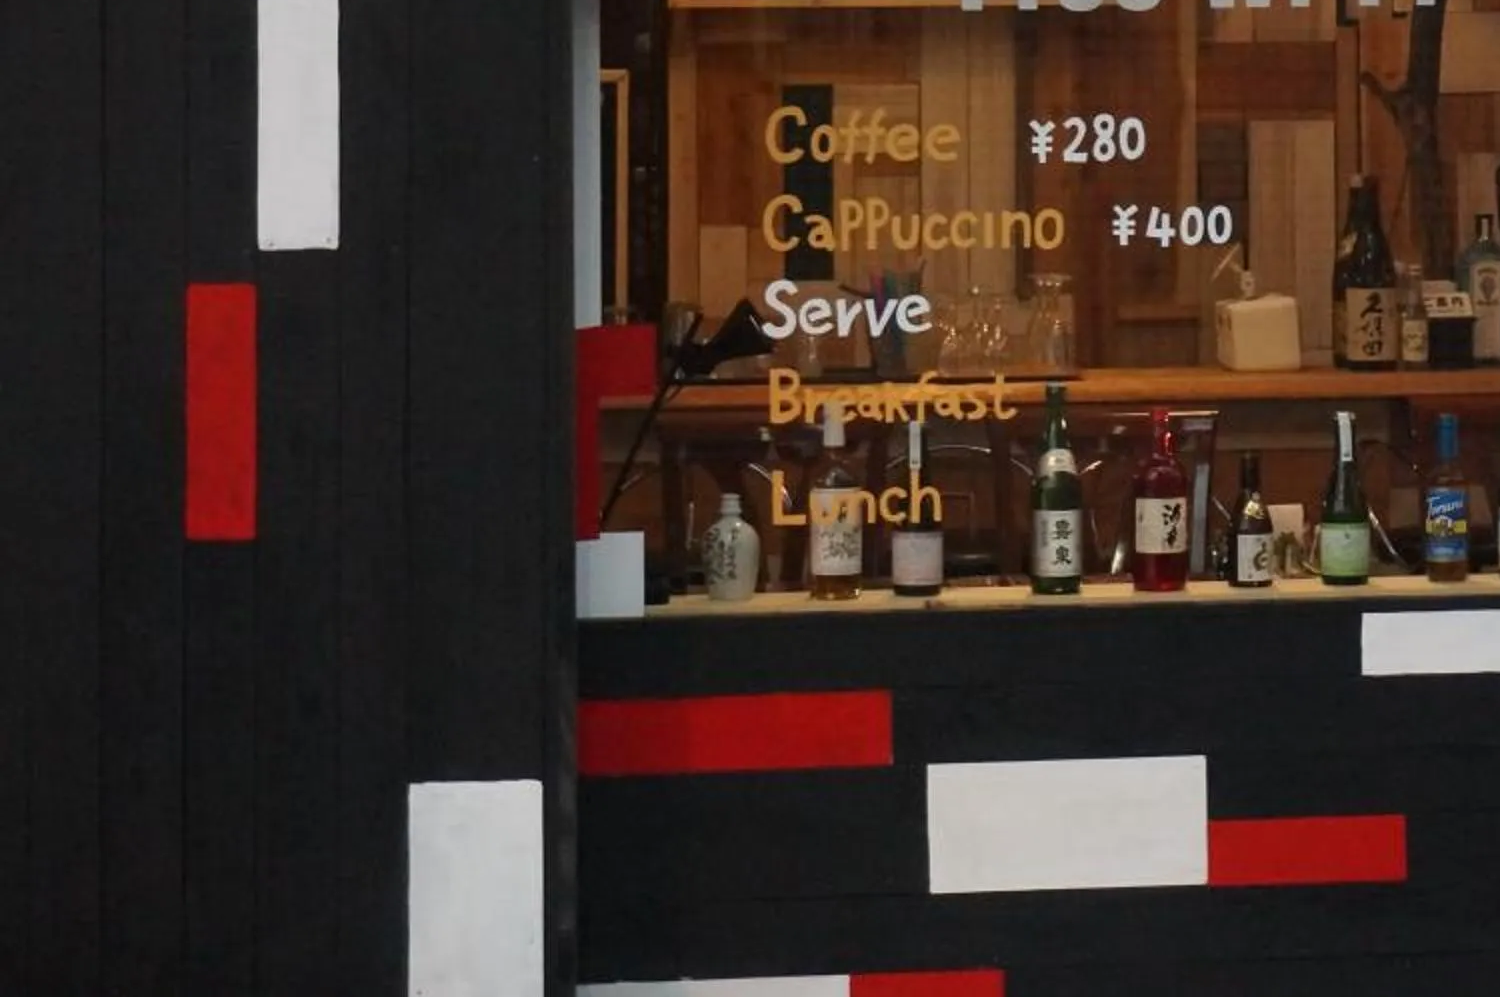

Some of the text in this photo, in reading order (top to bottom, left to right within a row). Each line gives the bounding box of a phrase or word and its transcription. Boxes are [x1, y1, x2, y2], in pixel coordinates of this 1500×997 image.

[765, 106, 1147, 165] Coffee ¥280
[1111, 204, 1233, 248] ¥400
[761, 279, 933, 340] Serve
[769, 368, 1018, 426] Breakfast
[771, 469, 943, 527] Lunch
